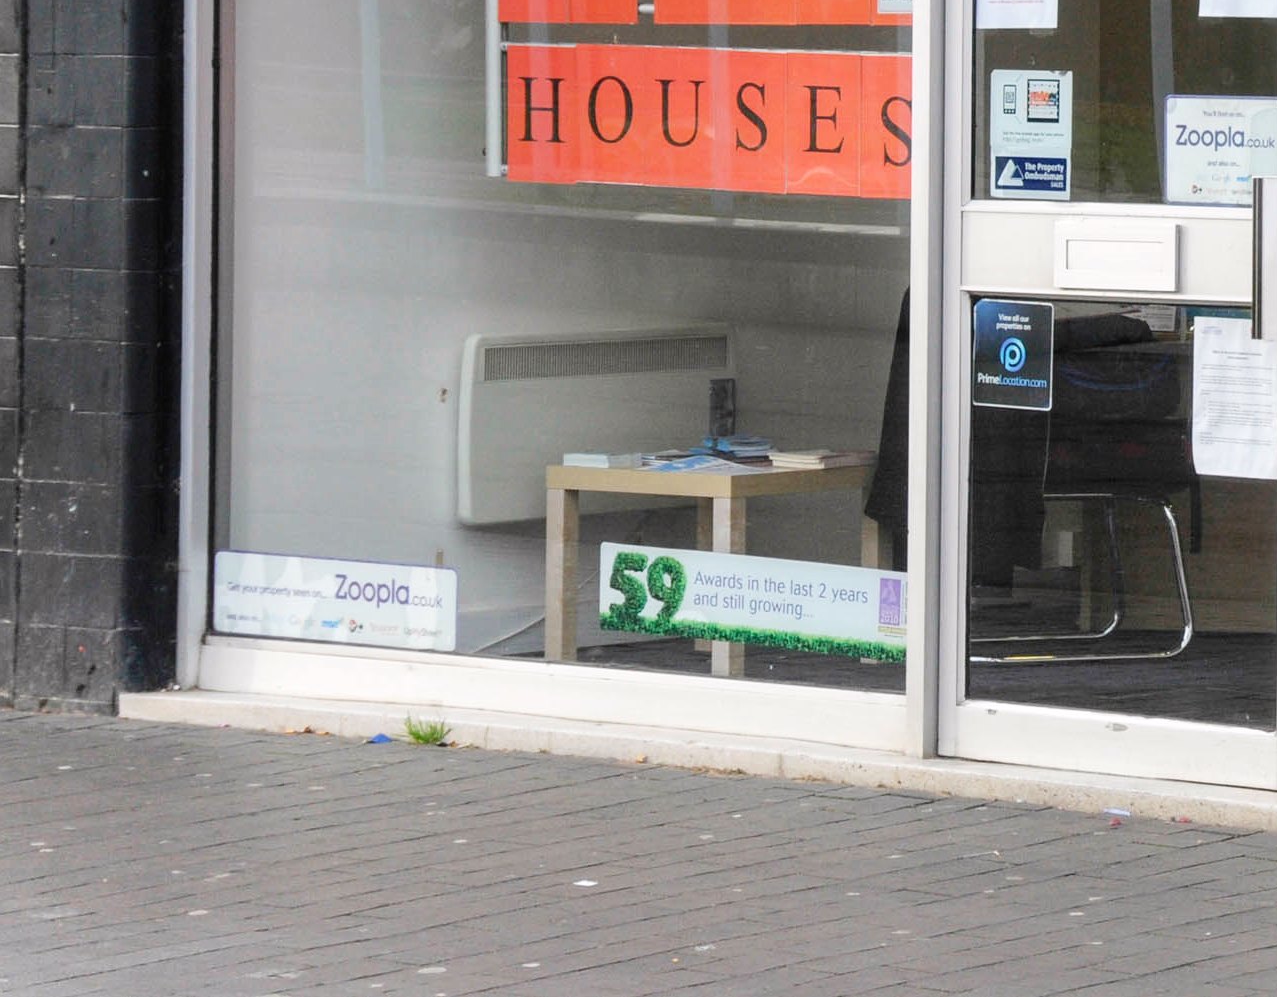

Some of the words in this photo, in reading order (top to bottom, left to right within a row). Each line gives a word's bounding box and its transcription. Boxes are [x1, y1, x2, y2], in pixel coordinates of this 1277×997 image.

[518, 76, 913, 167] HOUSES
[1175, 124, 1276, 152] Zoopla.co.uk
[1025, 162, 1036, 171] The
[1037, 163, 1064, 173] Property
[1025, 171, 1064, 182] Ombudsman
[977, 373, 1047, 388] PrimeLocation.com
[609, 551, 687, 619] 59
[694, 571, 743, 591] Awards
[748, 575, 760, 591] in
[762, 577, 785, 594] the
[790, 580, 813, 598] last
[818, 583, 827, 599] 2
[831, 588, 868, 605] years
[693, 592, 718, 607] and
[723, 593, 745, 610] still
